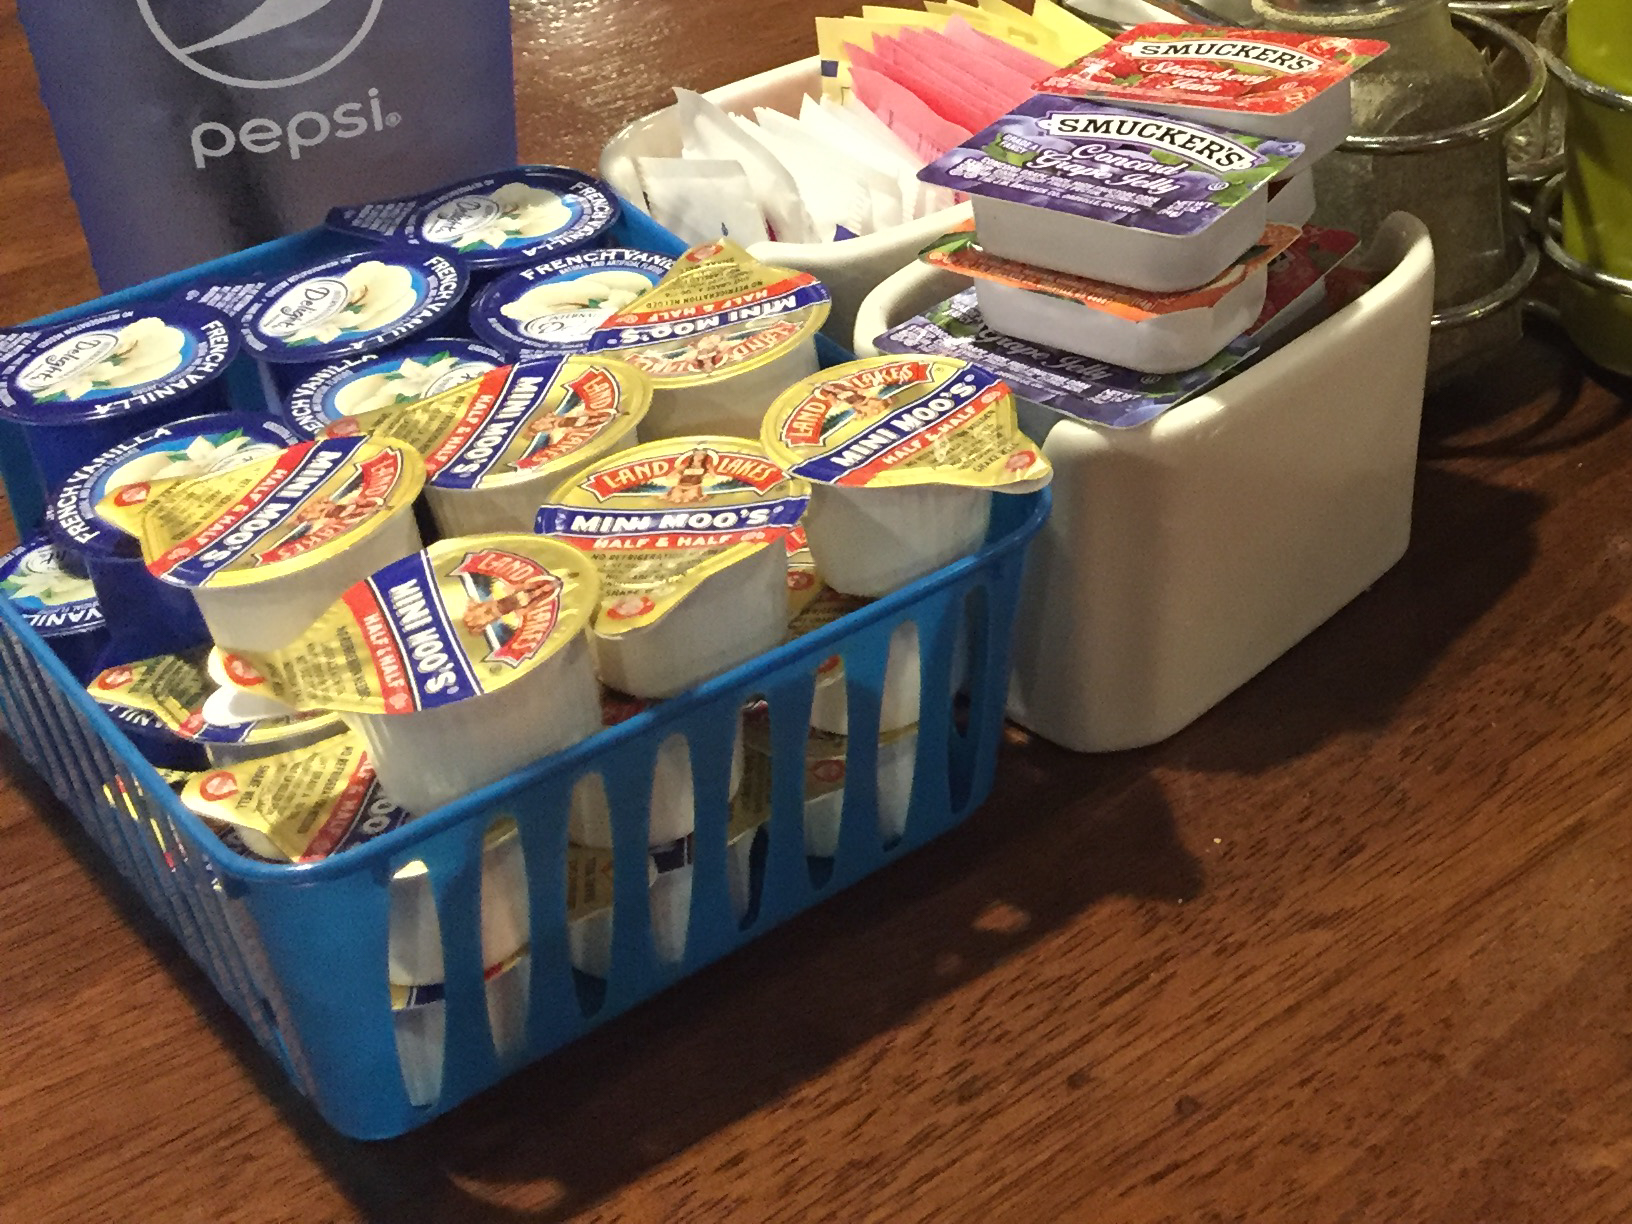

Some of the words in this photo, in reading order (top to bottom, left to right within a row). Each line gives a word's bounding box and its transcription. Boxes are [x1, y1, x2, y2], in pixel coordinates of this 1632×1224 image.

[1140, 60, 1273, 87] Strawberry
[1141, 40, 1314, 74] SMUCKER'S
[1164, 76, 1223, 94] Jam
[191, 88, 383, 169] pepsi
[1058, 117, 1244, 167] SMUCKER'S
[1026, 150, 1112, 180] Grape
[1104, 170, 1183, 195] Jelly
[1072, 144, 1192, 176] Concord
[424, 256, 458, 308] FRENCH
[519, 248, 616, 281] FRENCH
[648, 306, 698, 322] HALF
[736, 294, 797, 322] MINI
[738, 289, 768, 308] HALF
[201, 320, 229, 374] FRENCH
[620, 314, 721, 345] MOO'S
[733, 321, 798, 358] LAND
[92, 374, 204, 414] VANILLA
[469, 394, 495, 423] HALF
[502, 376, 543, 417] MINI
[584, 379, 617, 412] LAND
[793, 400, 826, 437] LAND
[851, 362, 915, 389] LAKES
[291, 398, 323, 433] ENCH
[830, 427, 899, 467] MINI
[891, 381, 977, 433] MOO'S
[881, 438, 923, 465] HALF
[938, 405, 977, 433] HALF
[70, 427, 173, 483] VANILLA
[434, 433, 463, 468] HALF
[453, 421, 508, 478] MOO'S
[249, 468, 288, 503] HALF
[285, 450, 344, 500] MINI
[365, 460, 398, 502] LAND
[601, 459, 669, 488] LAND
[716, 456, 772, 482] LAKES
[55, 475, 101, 545] FRENCH
[197, 513, 236, 546] HALF
[570, 513, 651, 533] MINI
[658, 508, 770, 529] MOO'S
[203, 500, 289, 570] MOO'S
[592, 537, 650, 549] HALF
[654, 536, 669, 548] &
[676, 533, 734, 548] HALF
[389, 579, 433, 631] MINI
[477, 554, 536, 581] LAND
[511, 605, 553, 653] LAKES
[363, 612, 387, 647] HALF
[379, 656, 406, 691] HALF
[408, 630, 459, 694] MOO'S
